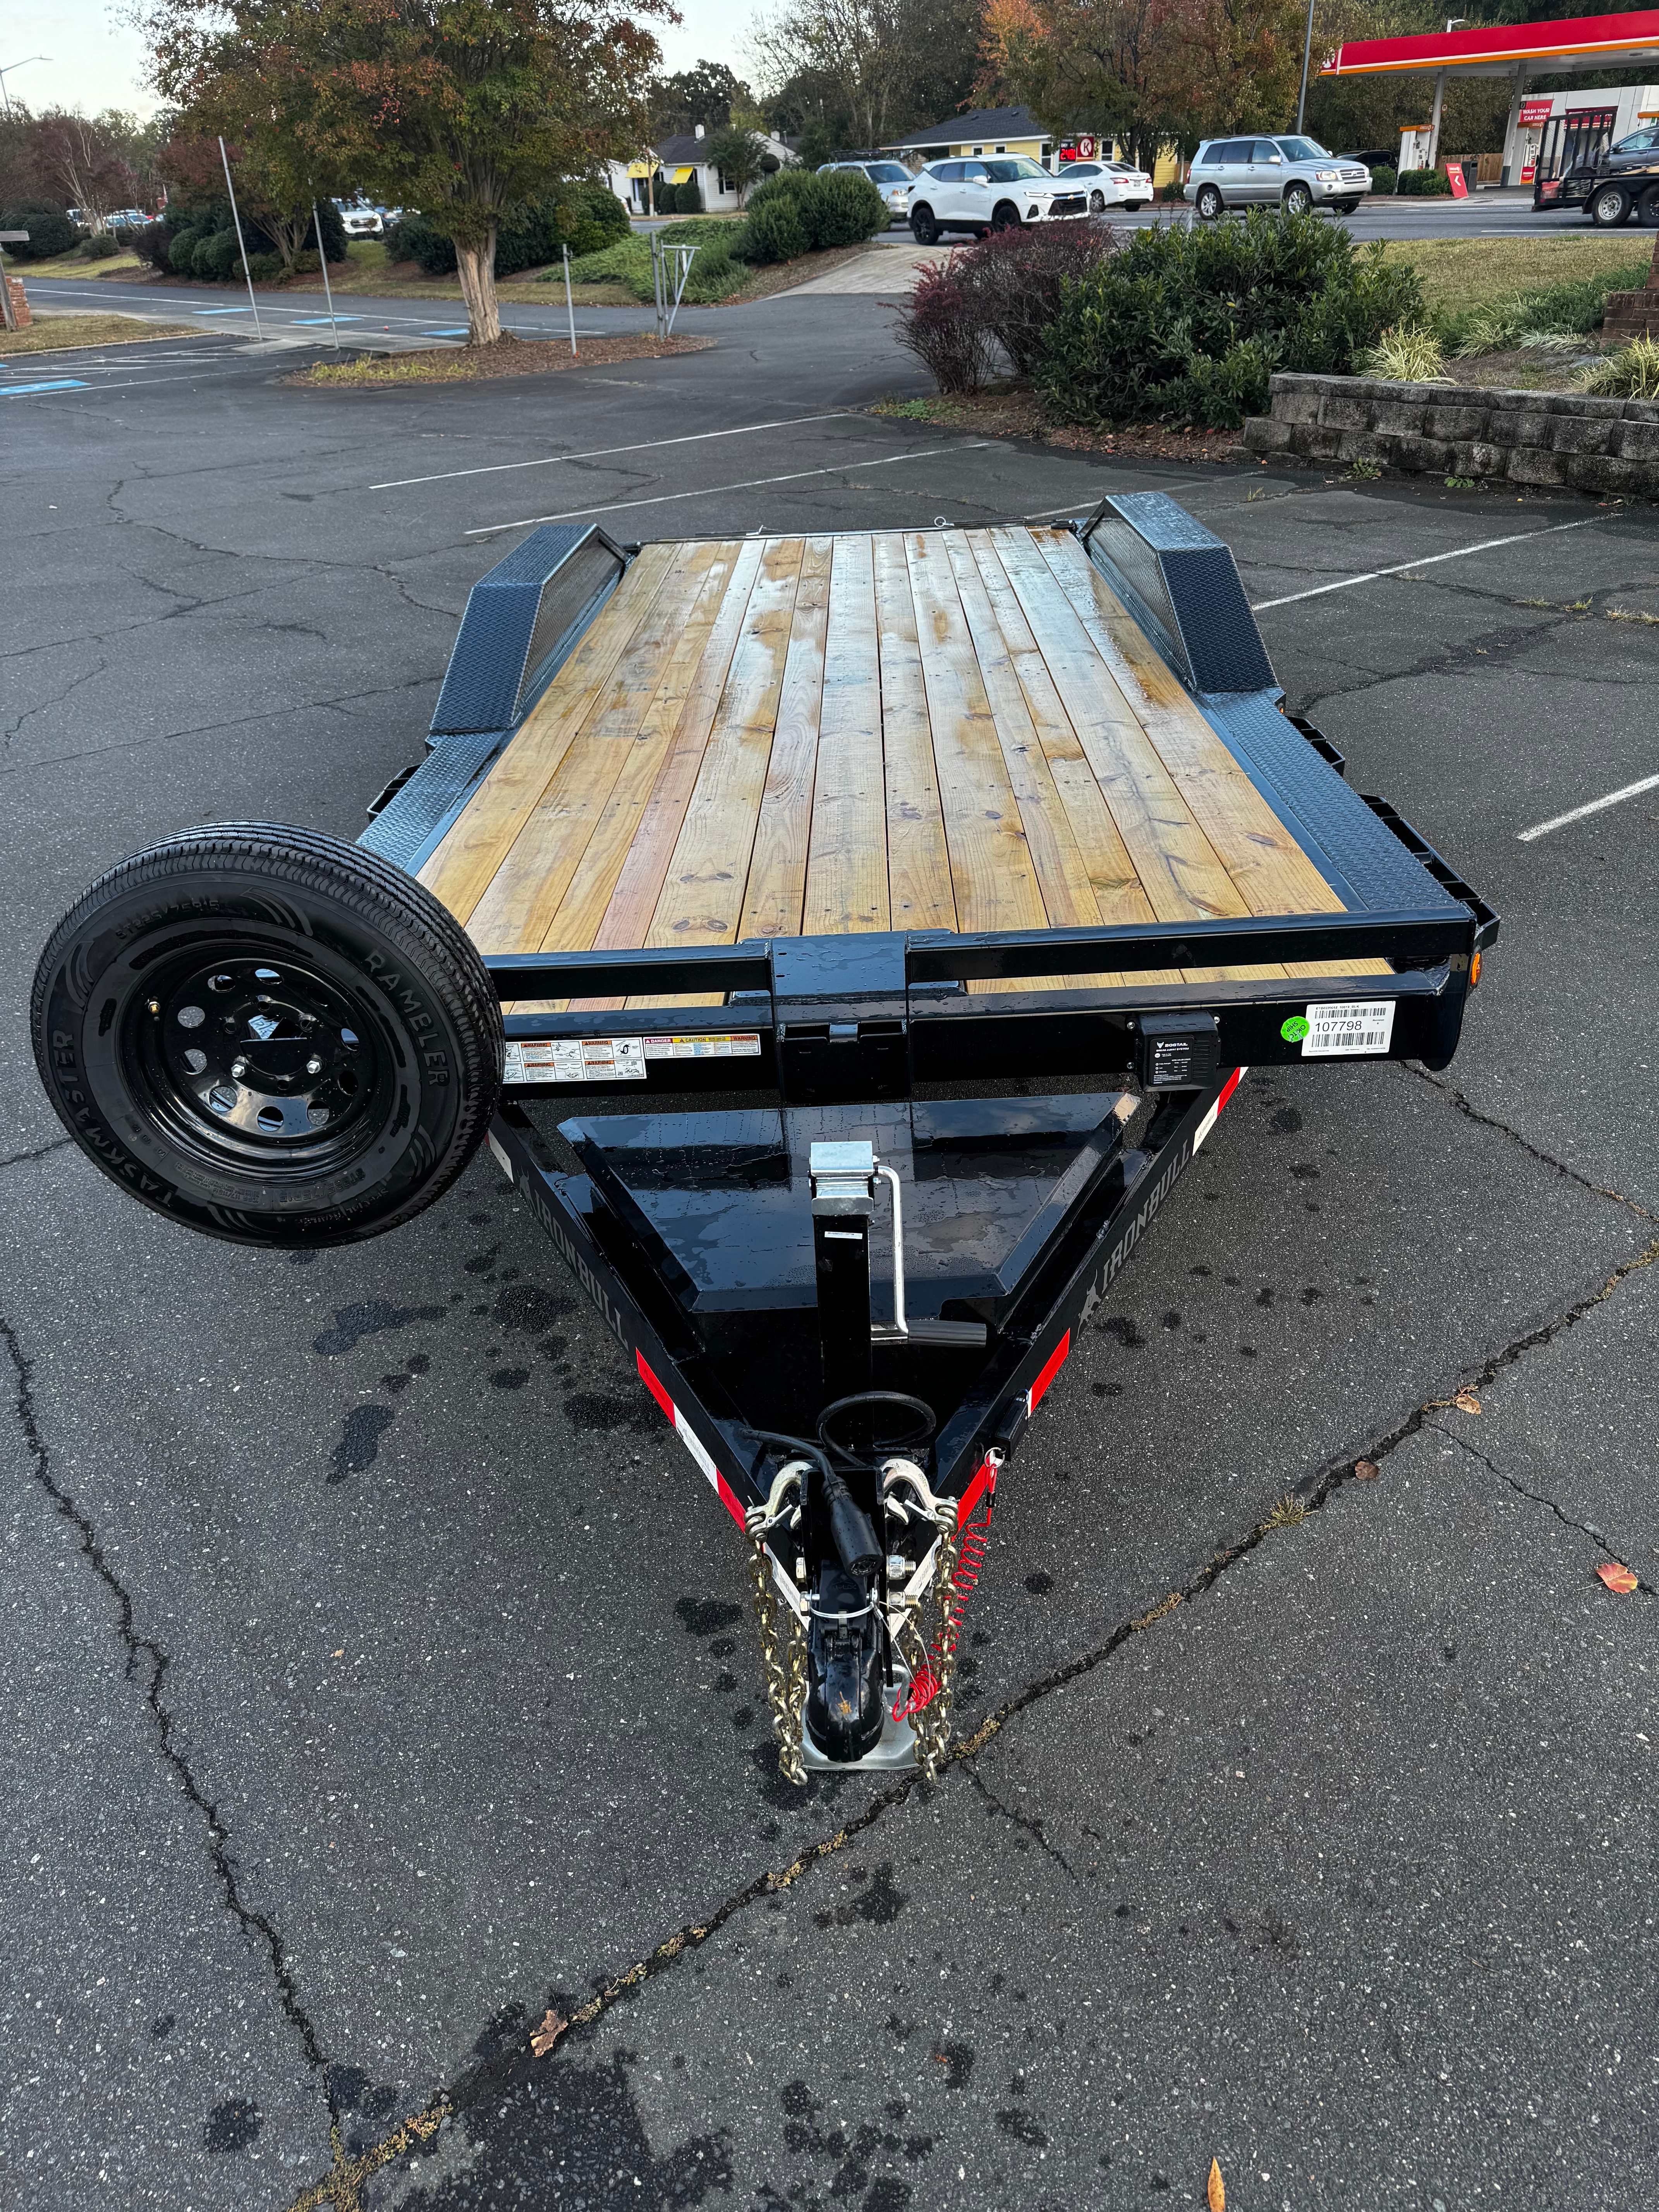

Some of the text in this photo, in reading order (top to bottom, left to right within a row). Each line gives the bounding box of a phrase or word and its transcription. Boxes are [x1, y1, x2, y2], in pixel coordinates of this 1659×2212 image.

[364, 949, 450, 1087] RAMBLER
[1286, 1021, 1298, 1032] SHIP
[1296, 1025, 1306, 1033] OK
[1315, 1020, 1362, 1032] 107798
[53, 1029, 173, 1207] TASKMASTER
[534, 1189, 629, 1352] IRONBULL
[1102, 1139, 1190, 1295] IRONBULL
